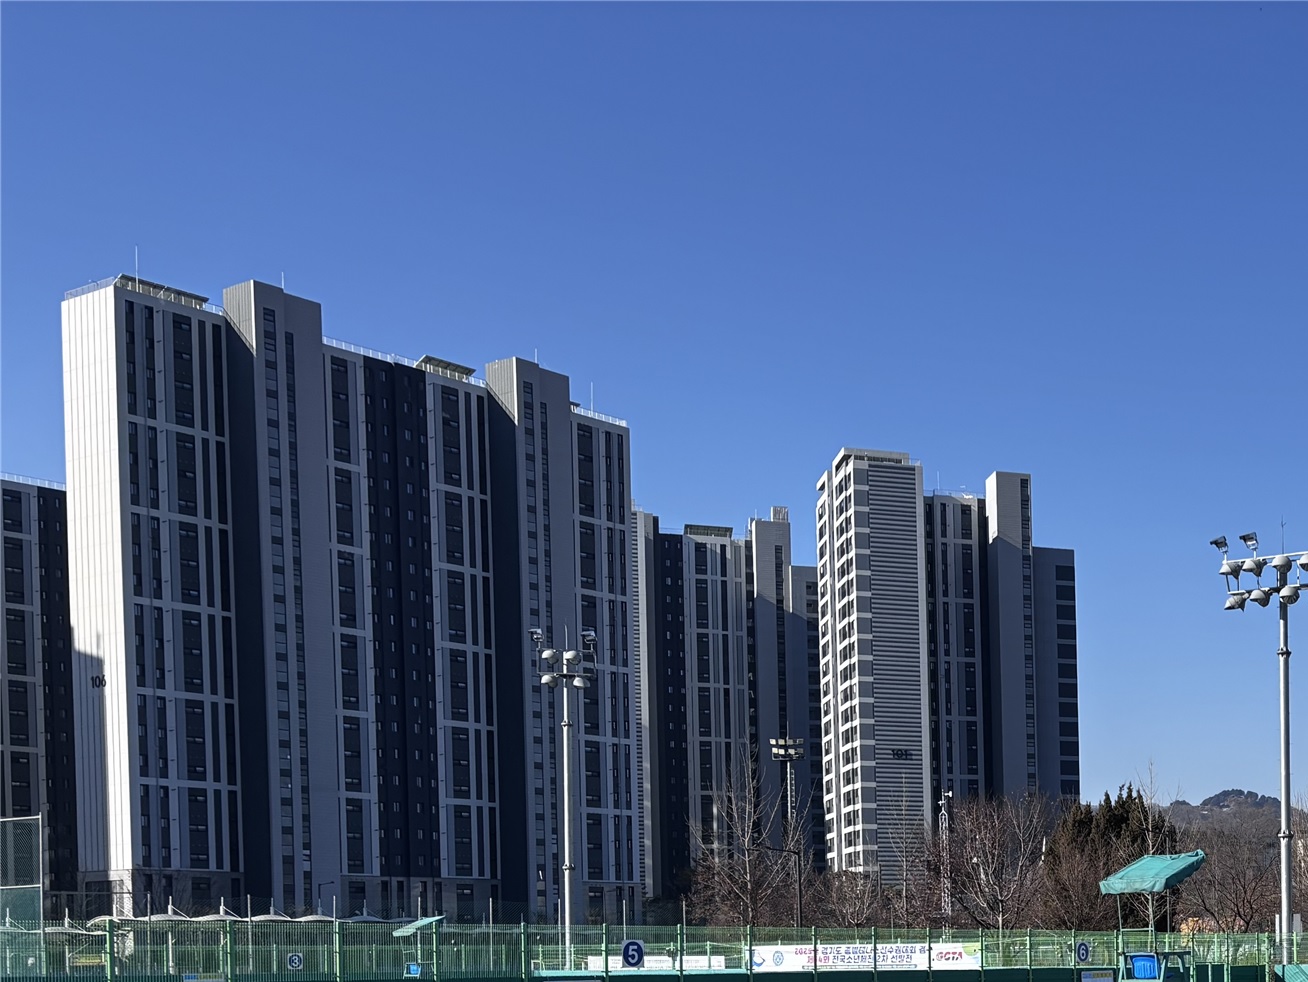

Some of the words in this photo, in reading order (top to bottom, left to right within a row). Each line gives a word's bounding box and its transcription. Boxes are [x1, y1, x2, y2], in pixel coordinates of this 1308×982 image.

[90, 674, 107, 689] 106
[628, 945, 639, 964] 5
[1080, 945, 1087, 960] 6
